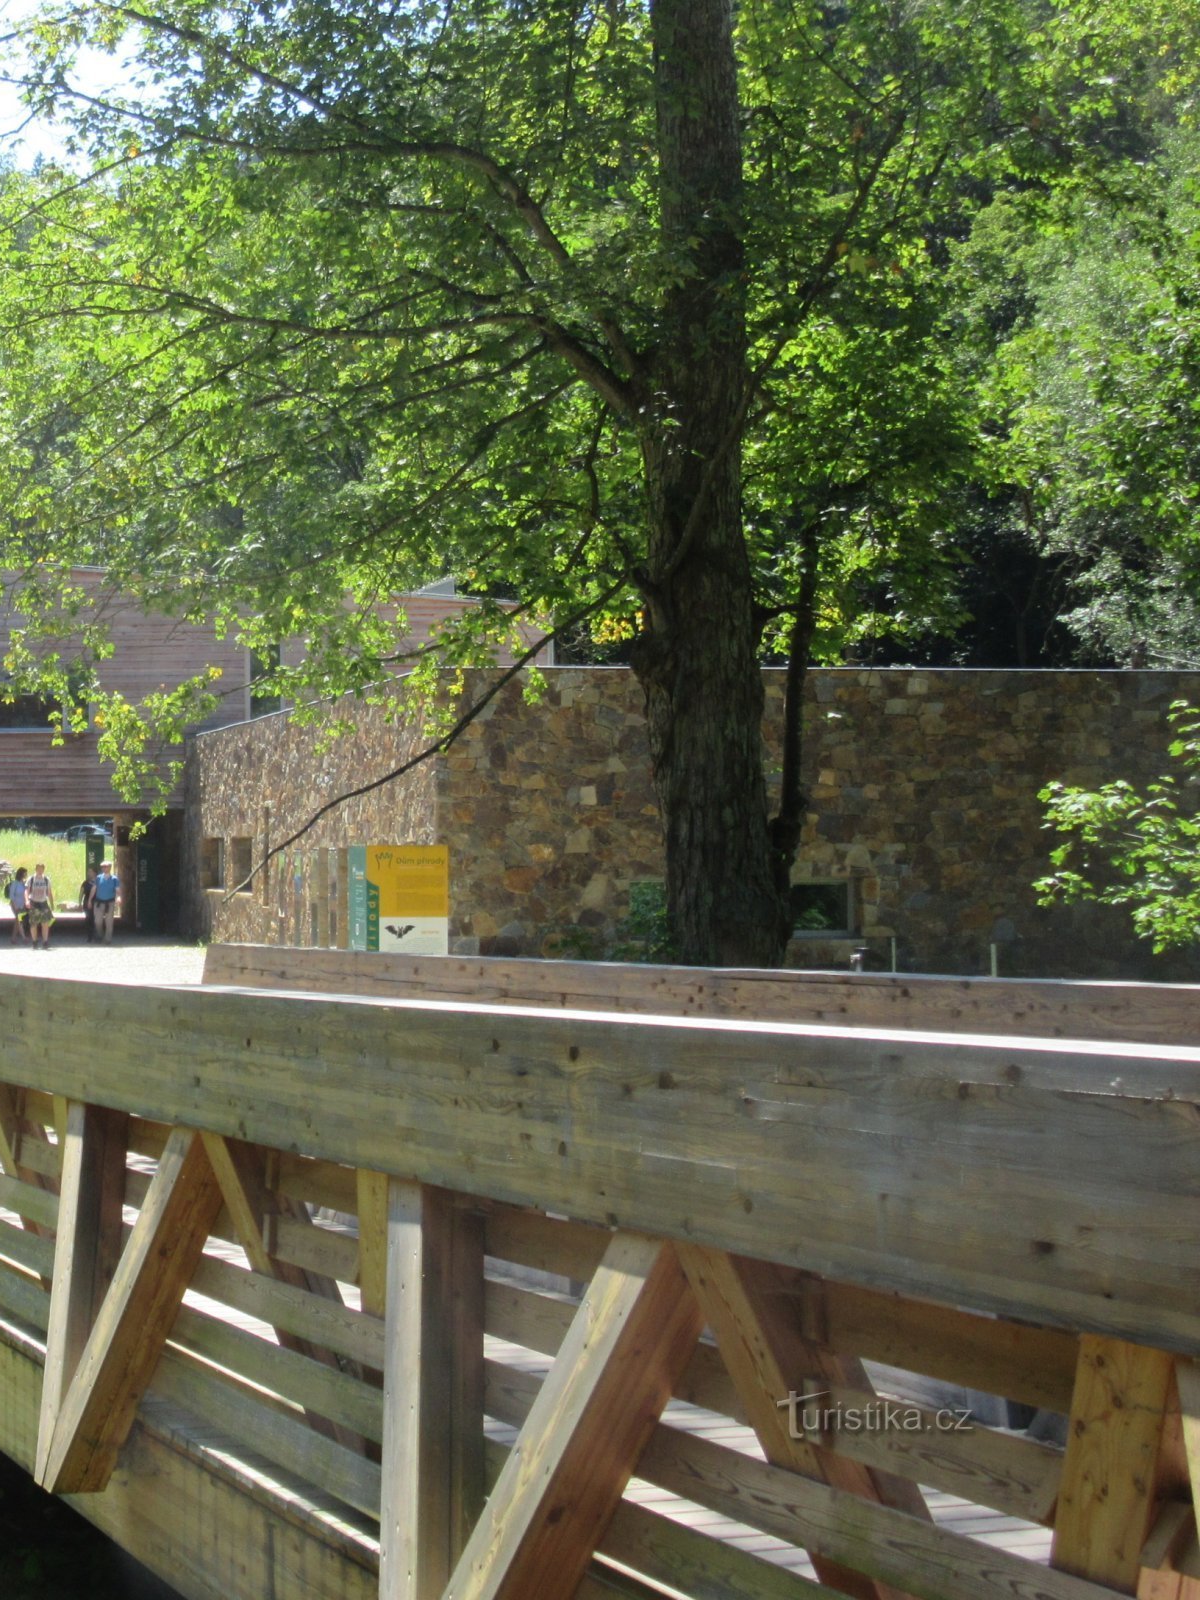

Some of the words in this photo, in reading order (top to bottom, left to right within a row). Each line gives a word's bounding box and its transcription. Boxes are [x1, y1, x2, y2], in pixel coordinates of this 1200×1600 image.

[88, 851, 95, 865] WC
[395, 855, 415, 865] Dům
[139, 859, 148, 882] kino
